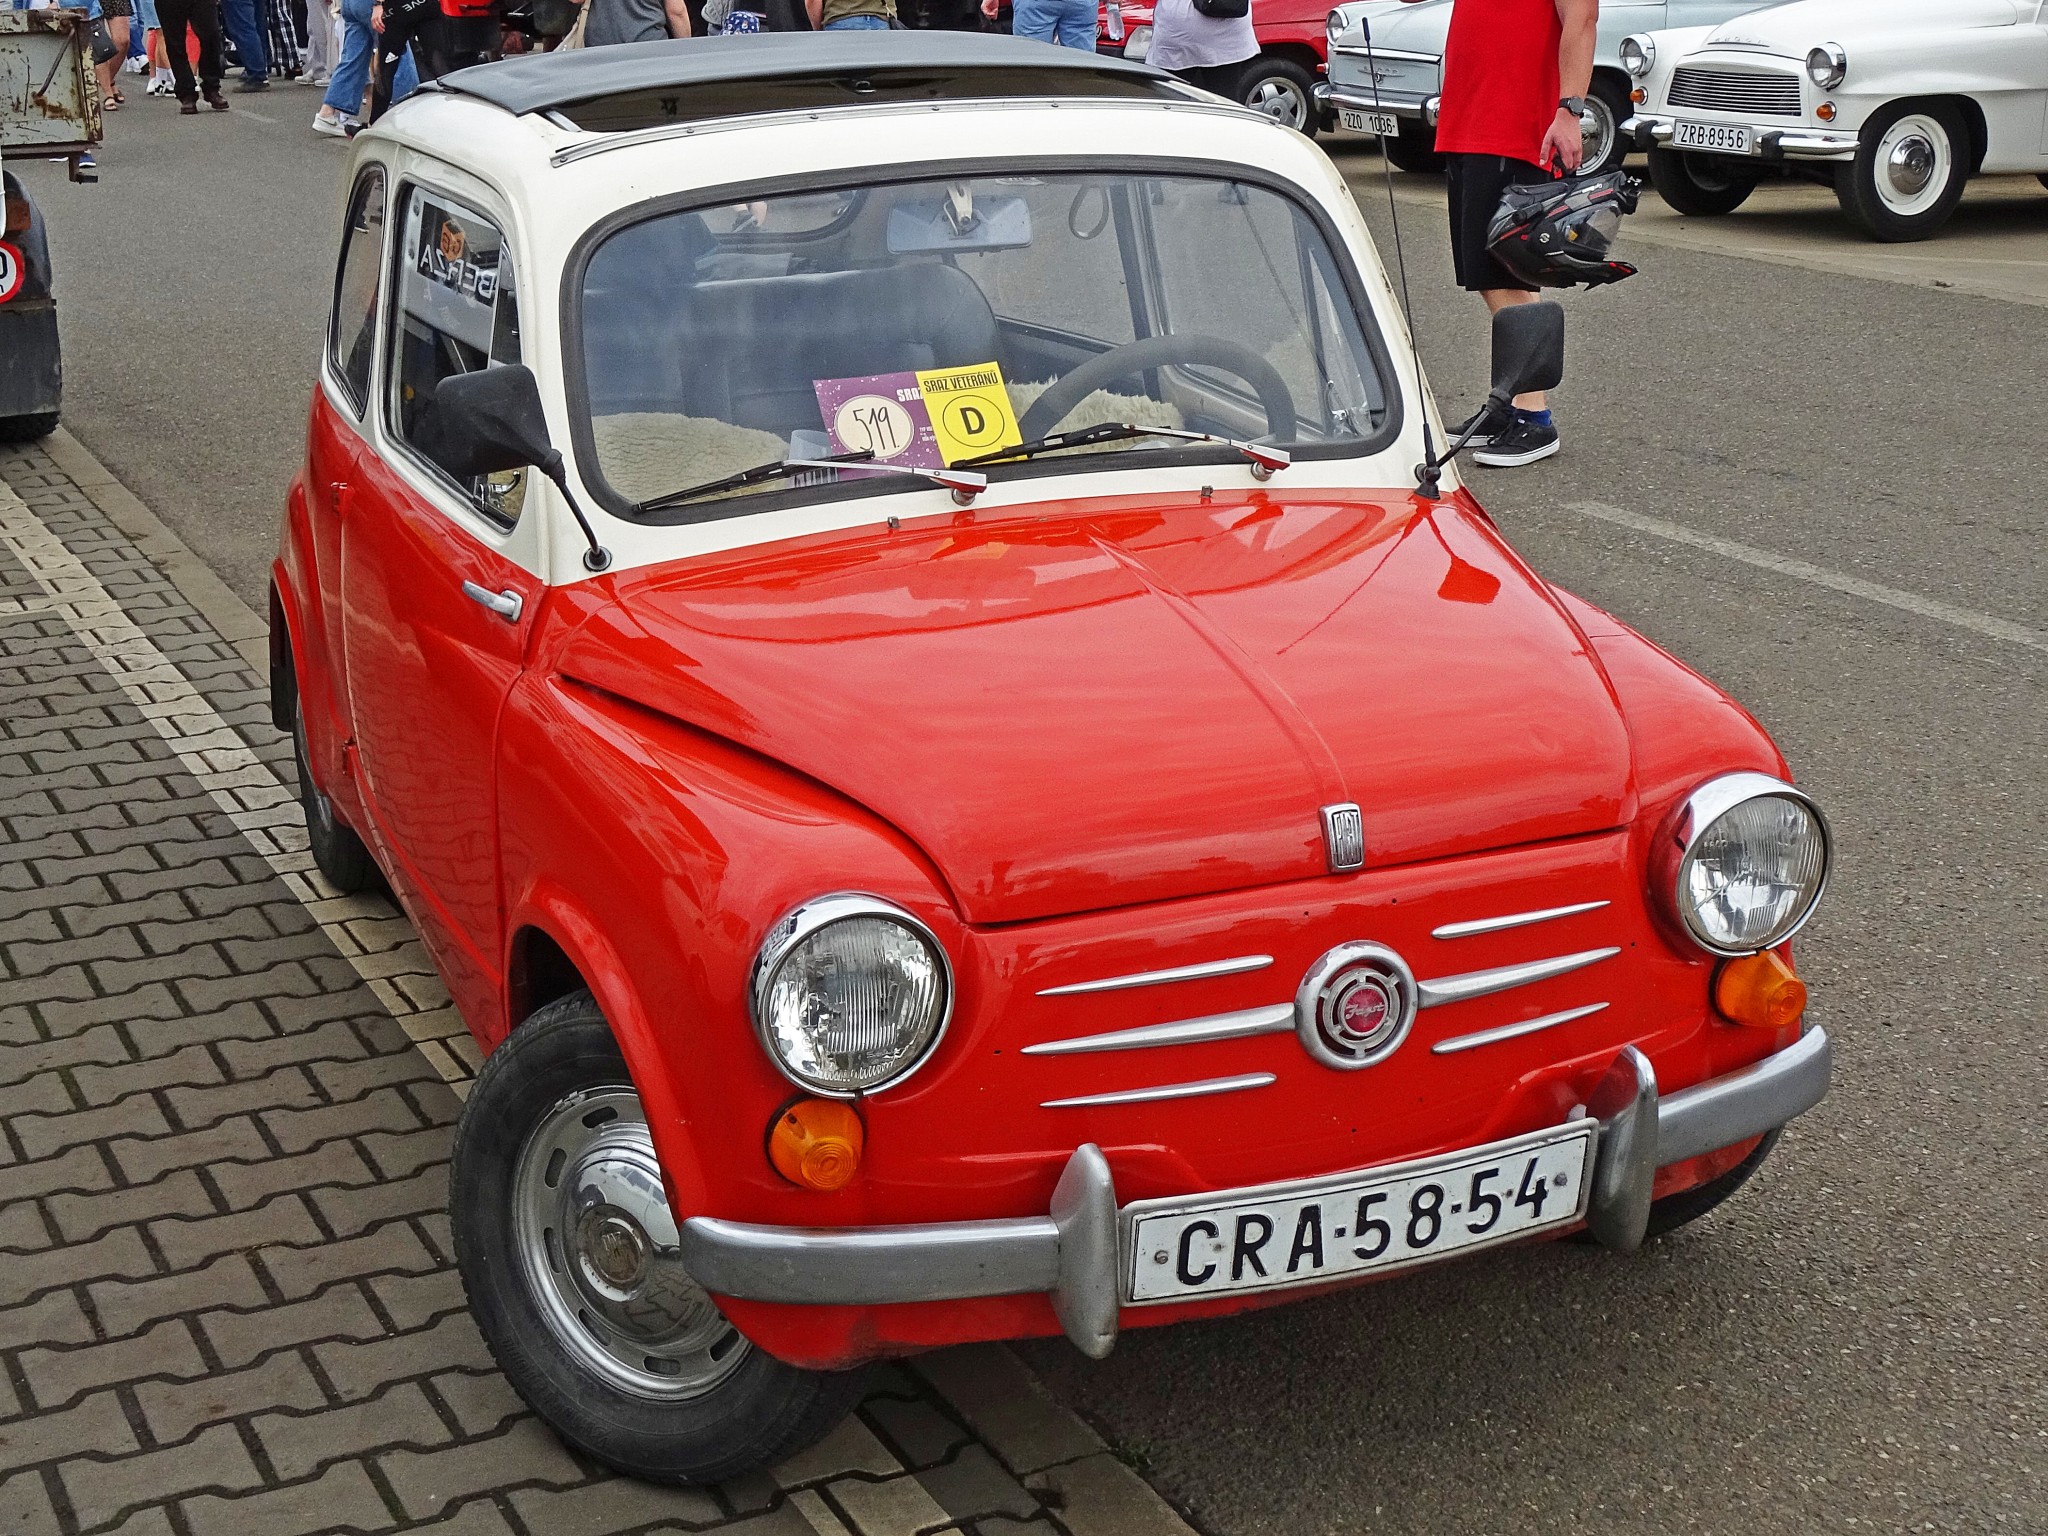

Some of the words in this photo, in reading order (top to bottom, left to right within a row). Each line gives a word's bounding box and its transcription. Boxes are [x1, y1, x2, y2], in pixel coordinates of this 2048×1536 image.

[1369, 116, 1393, 133] 1036
[923, 378, 950, 393] SRAZ
[949, 370, 999, 390] VETERÁNŮ
[959, 406, 985, 435] D
[1332, 811, 1361, 866] FIAT
